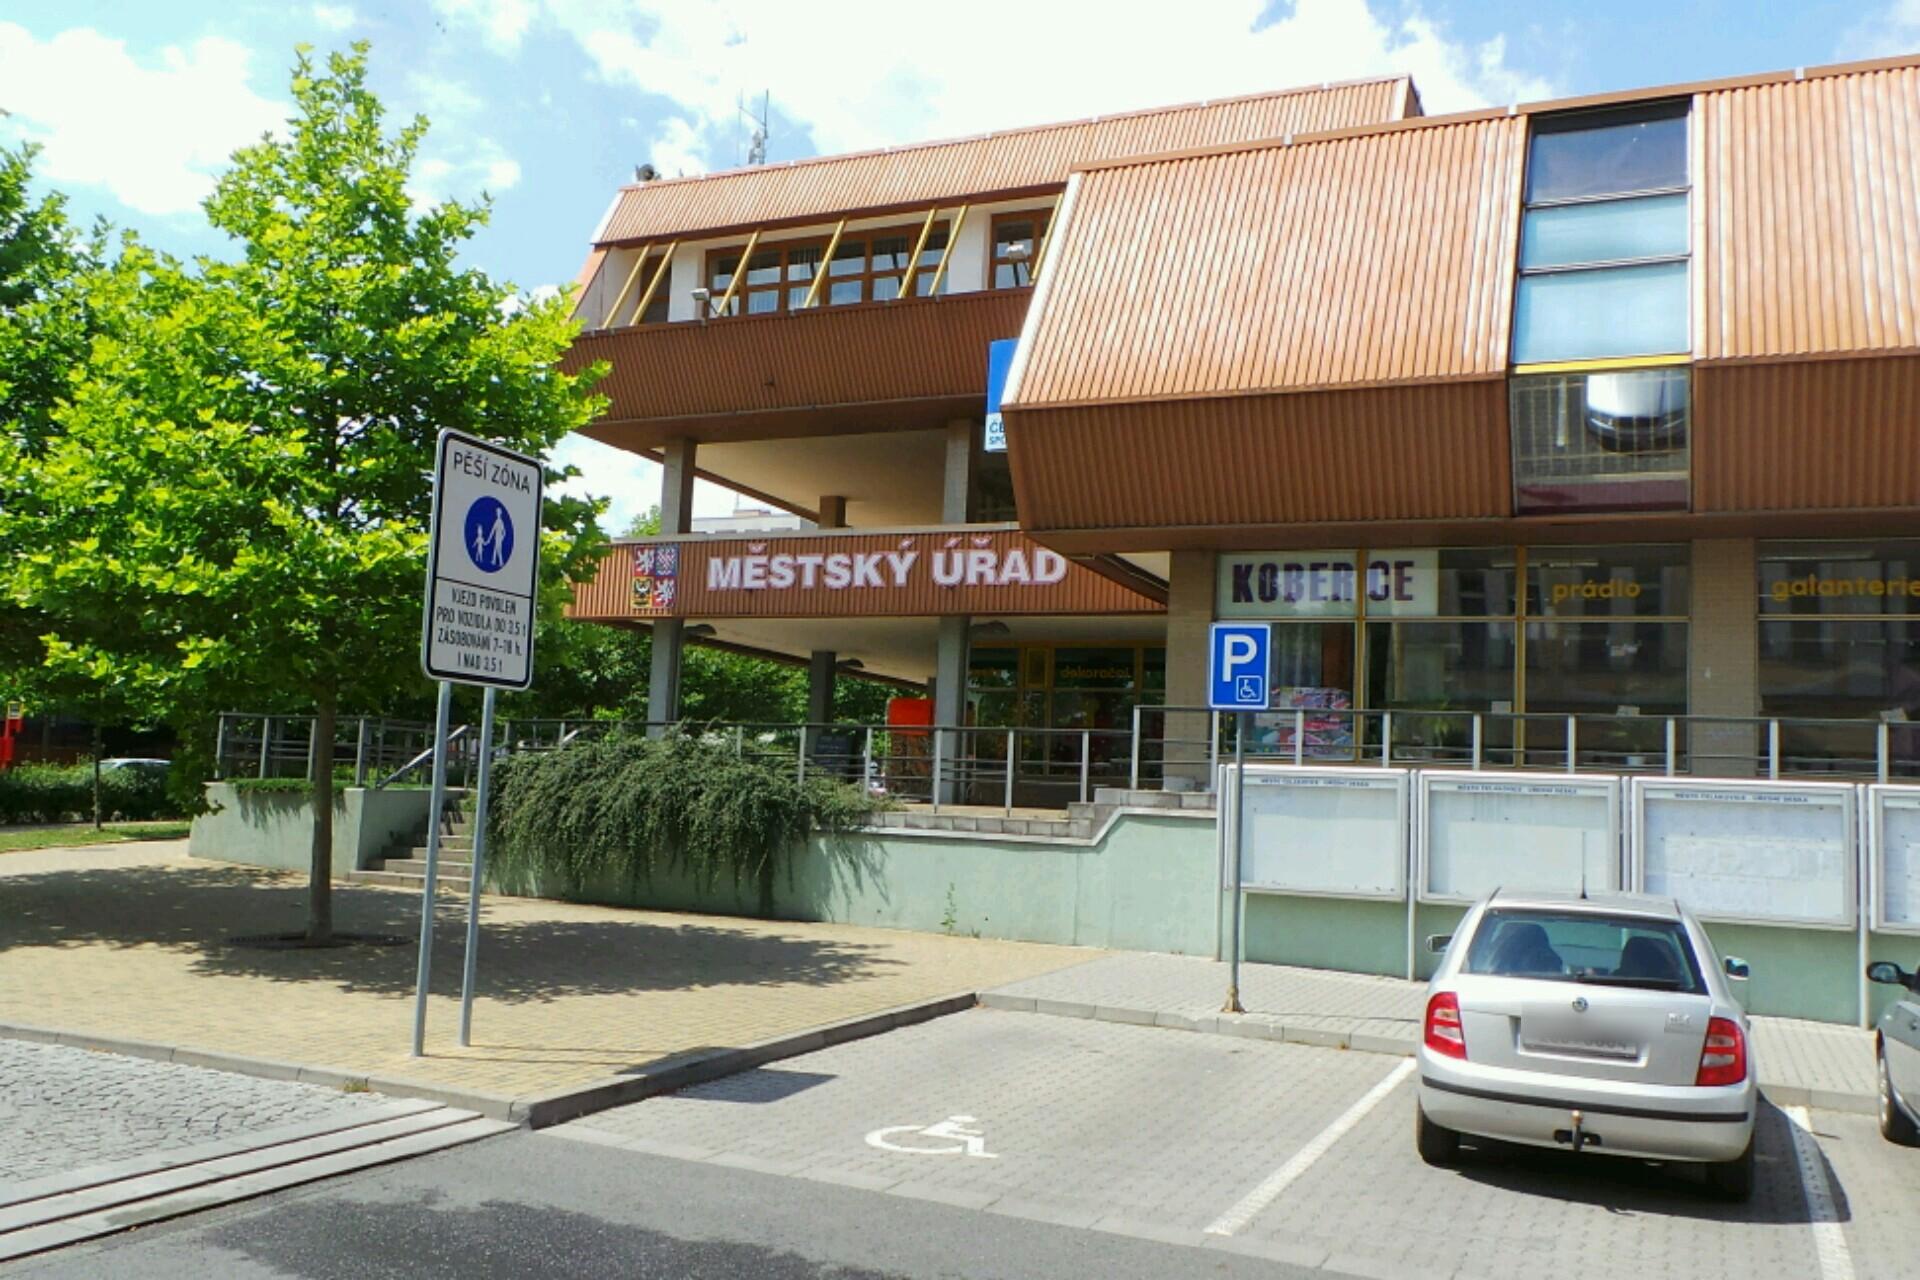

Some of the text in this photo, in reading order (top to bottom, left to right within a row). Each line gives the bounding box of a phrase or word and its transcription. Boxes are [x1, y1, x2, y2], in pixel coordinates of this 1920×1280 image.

[453, 450, 530, 495] PĚŠÍ ZÓNA
[707, 536, 1068, 592] MĚSTSKÝ ÚŘAD
[451, 587, 517, 616] VJEZD POVOLEN
[1552, 578, 1641, 604] prádlo
[436, 606, 455, 624] PRO
[458, 609, 492, 631] VOZIDLA
[494, 618, 506, 633] DO
[437, 625, 491, 651] ZÁSOBOVÁNÍ
[464, 653, 481, 670] NAD
[1222, 634, 1258, 682] P
